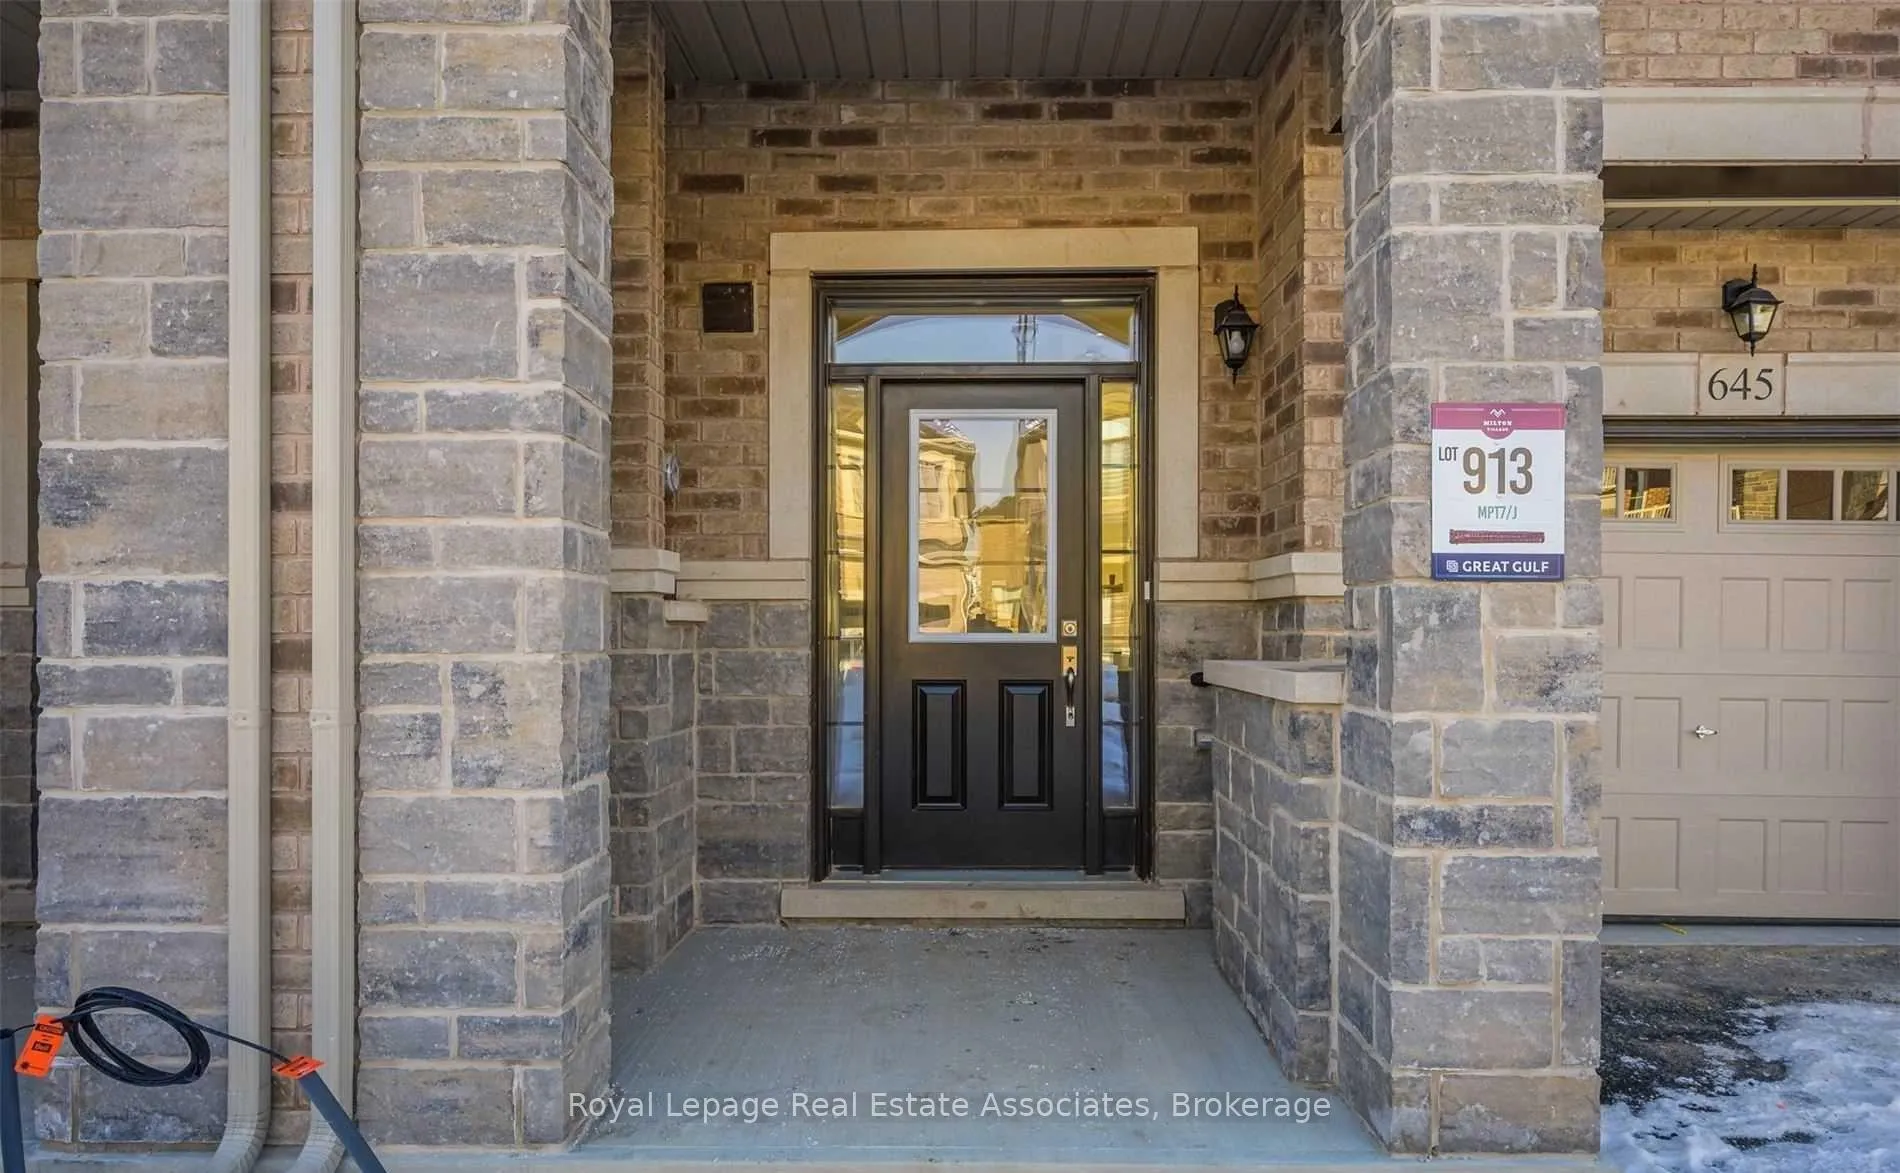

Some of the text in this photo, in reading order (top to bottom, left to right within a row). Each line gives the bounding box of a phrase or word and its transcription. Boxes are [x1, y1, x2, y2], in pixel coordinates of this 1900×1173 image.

[1708, 367, 1774, 401] 645
[1438, 446, 1533, 495] LOT 913
[1477, 505, 1518, 520] MPT7/J
[1462, 560, 1549, 573] GREAT GULF
